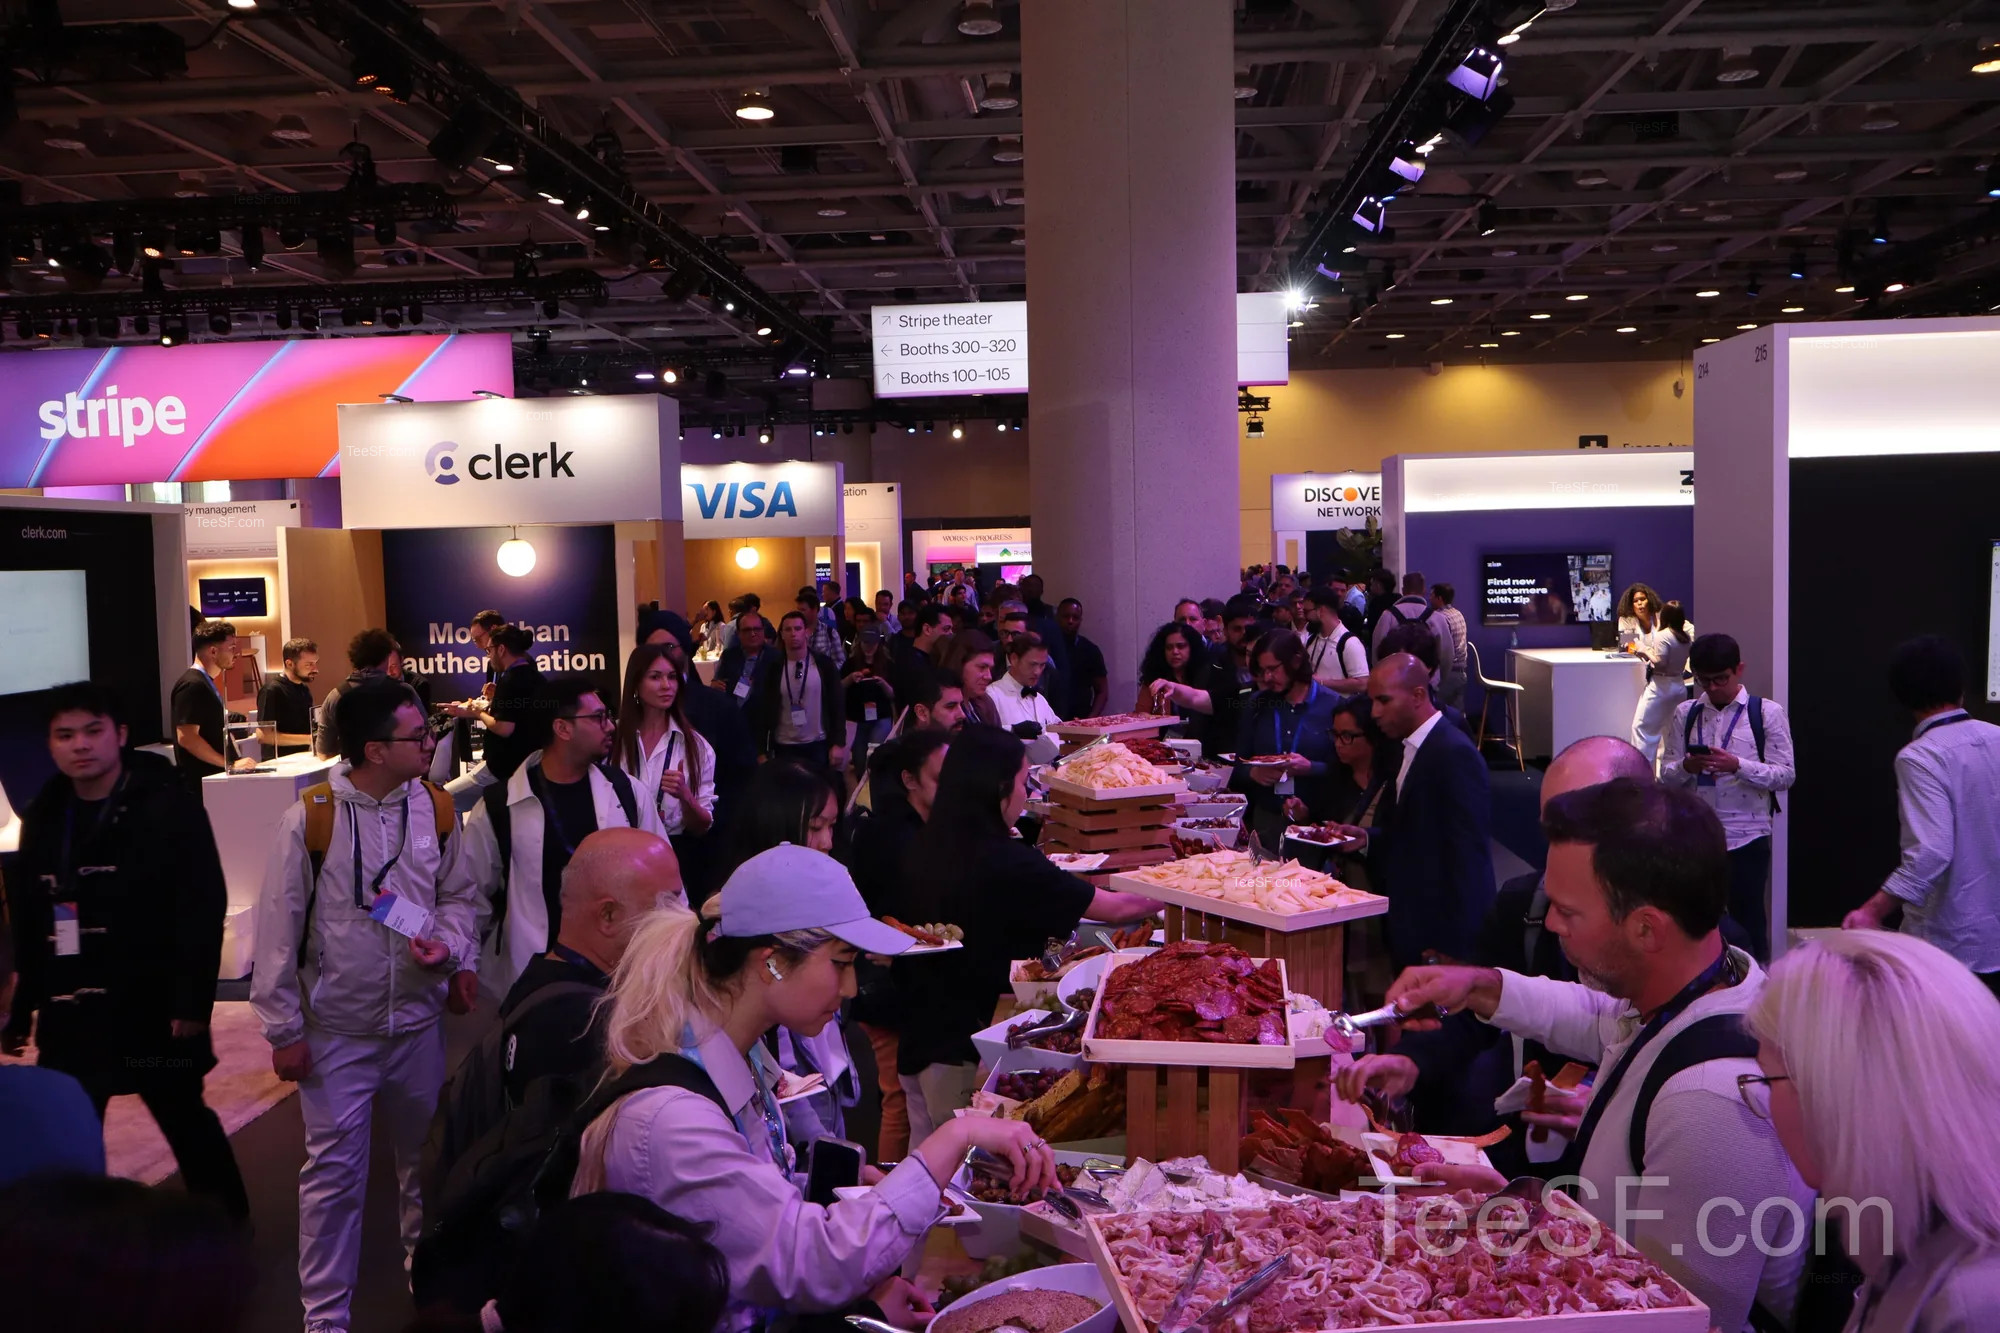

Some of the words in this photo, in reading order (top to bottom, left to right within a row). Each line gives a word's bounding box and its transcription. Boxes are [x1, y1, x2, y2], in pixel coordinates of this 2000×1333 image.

[899, 314, 940, 329] Stripe
[943, 313, 992, 326] theater
[900, 342, 949, 356] Booths
[1755, 344, 1768, 362] 215
[1698, 362, 1709, 379] 214
[901, 371, 949, 385] Booths
[38, 385, 187, 448] stripe
[468, 442, 575, 480] clerk
[843, 487, 867, 497] ation
[1305, 487, 1380, 503] DISCOVE
[686, 481, 798, 519] VISA
[184, 507, 194, 517] ey
[195, 504, 257, 516] management
[1317, 506, 1381, 517] NETWORK
[21, 525, 67, 539] clerk.com
[975, 533, 1013, 541] PROGRESS
[1487, 578, 1511, 586] Find
[1487, 587, 1548, 595] customers
[1487, 595, 1511, 604] with
[1512, 595, 1531, 605] Zip
[429, 622, 473, 645] Mo
[511, 620, 570, 643] han
